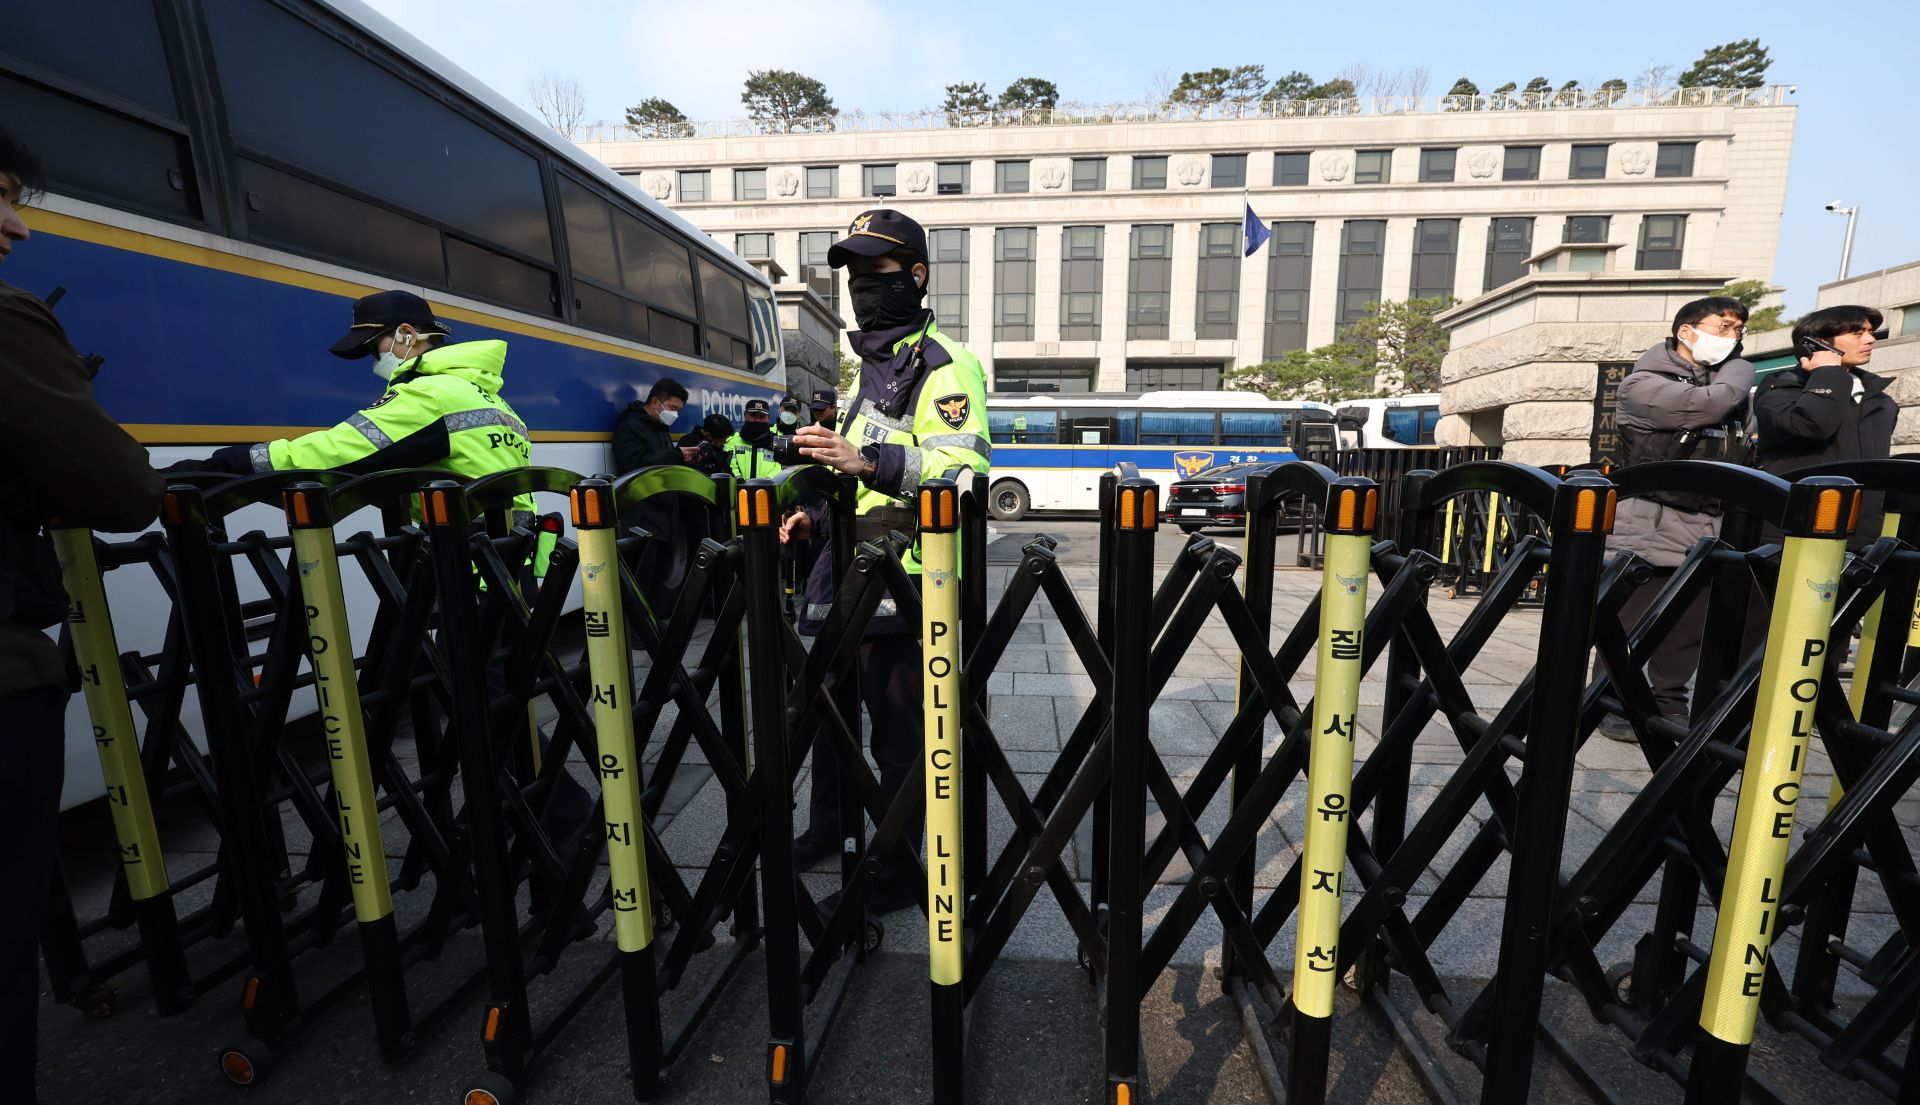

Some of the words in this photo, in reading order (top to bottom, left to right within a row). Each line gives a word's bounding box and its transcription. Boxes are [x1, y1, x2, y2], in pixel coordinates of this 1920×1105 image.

[306, 605, 344, 761] POLICE
[337, 790, 364, 885] LINE
[585, 610, 637, 912] 질서유지선
[928, 621, 952, 800] POLICE
[1306, 629, 1363, 972] 질서유지선
[1771, 638, 1826, 839] POLICE
[935, 834, 953, 942] LINE
[1741, 877, 1777, 998] LINE
